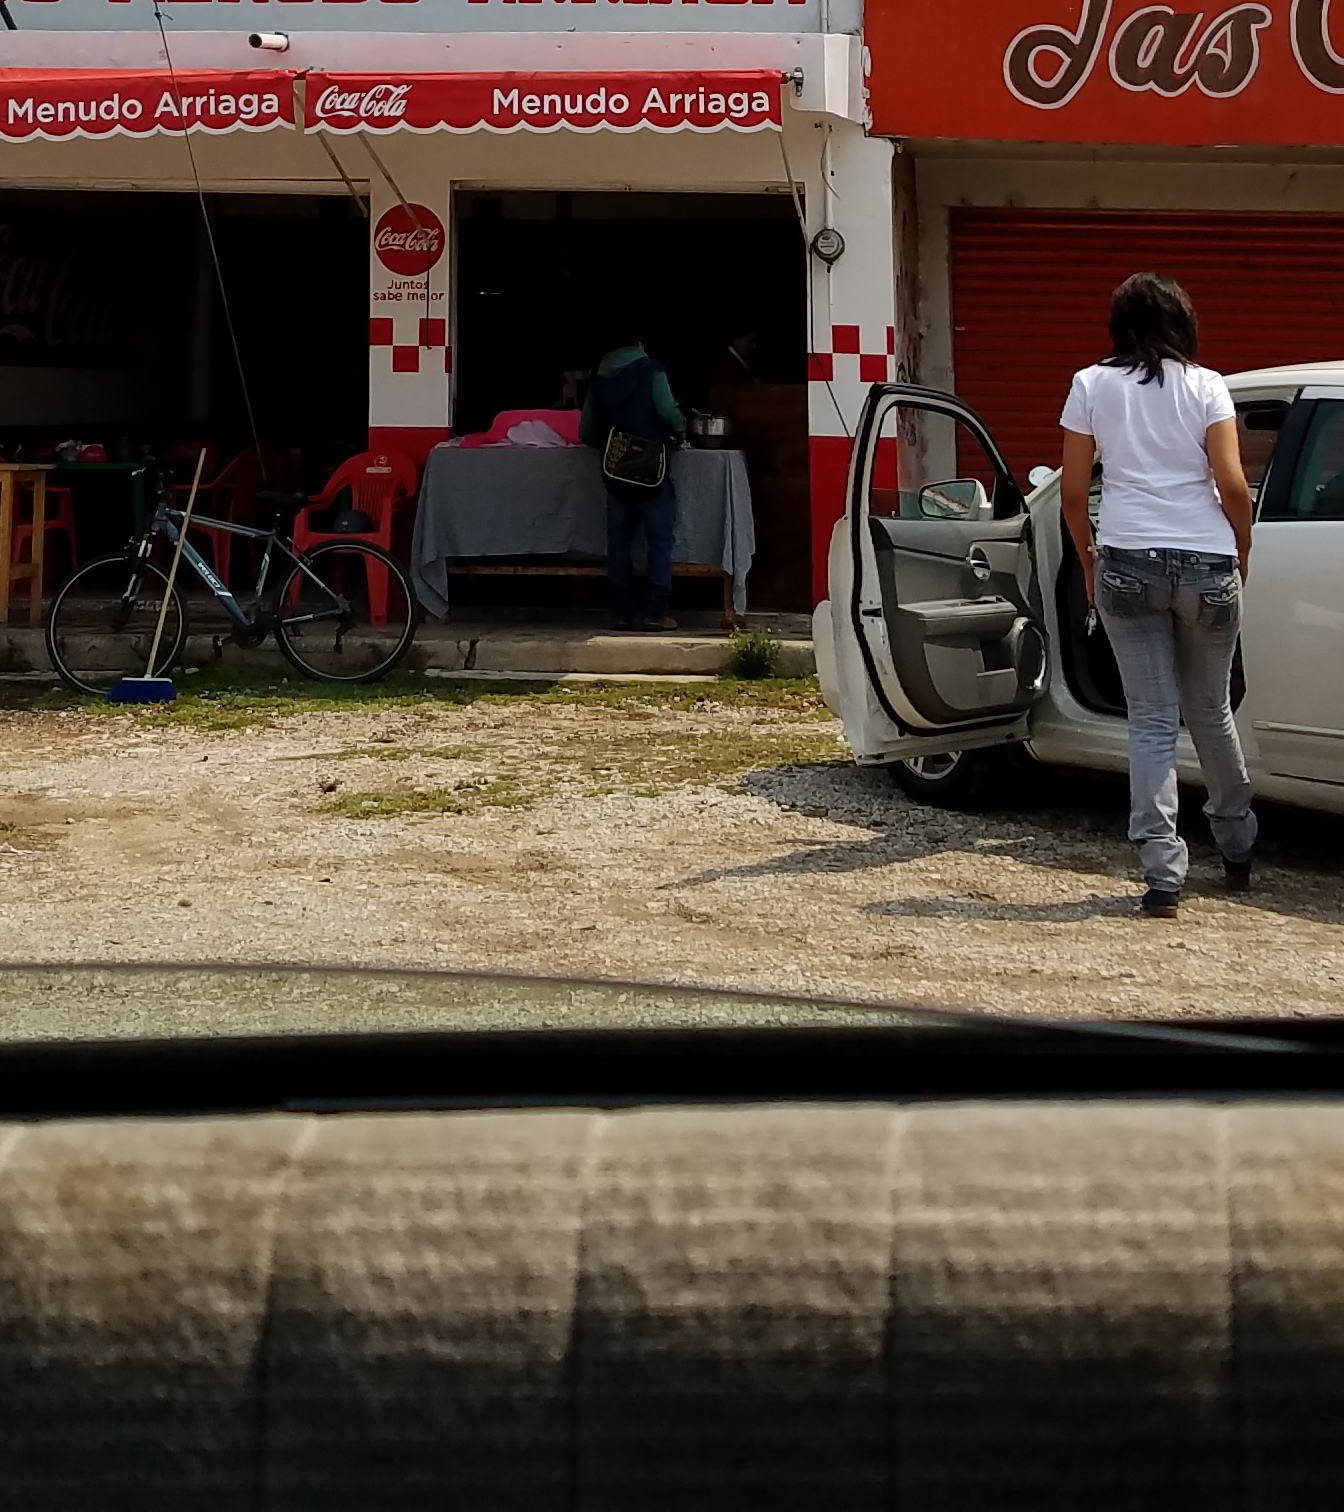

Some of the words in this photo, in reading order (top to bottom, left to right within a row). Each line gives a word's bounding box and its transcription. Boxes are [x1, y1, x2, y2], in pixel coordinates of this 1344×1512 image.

[7, 94, 141, 125] Menudo
[152, 87, 281, 124] Arriaga
[315, 84, 413, 118] Coca-Cola
[491, 88, 632, 116] Menudo
[642, 88, 771, 118] Arriaga
[375, 226, 441, 252] Coca-Cola
[373, 290, 403, 301] sabe
[407, 291, 445, 301] meor
